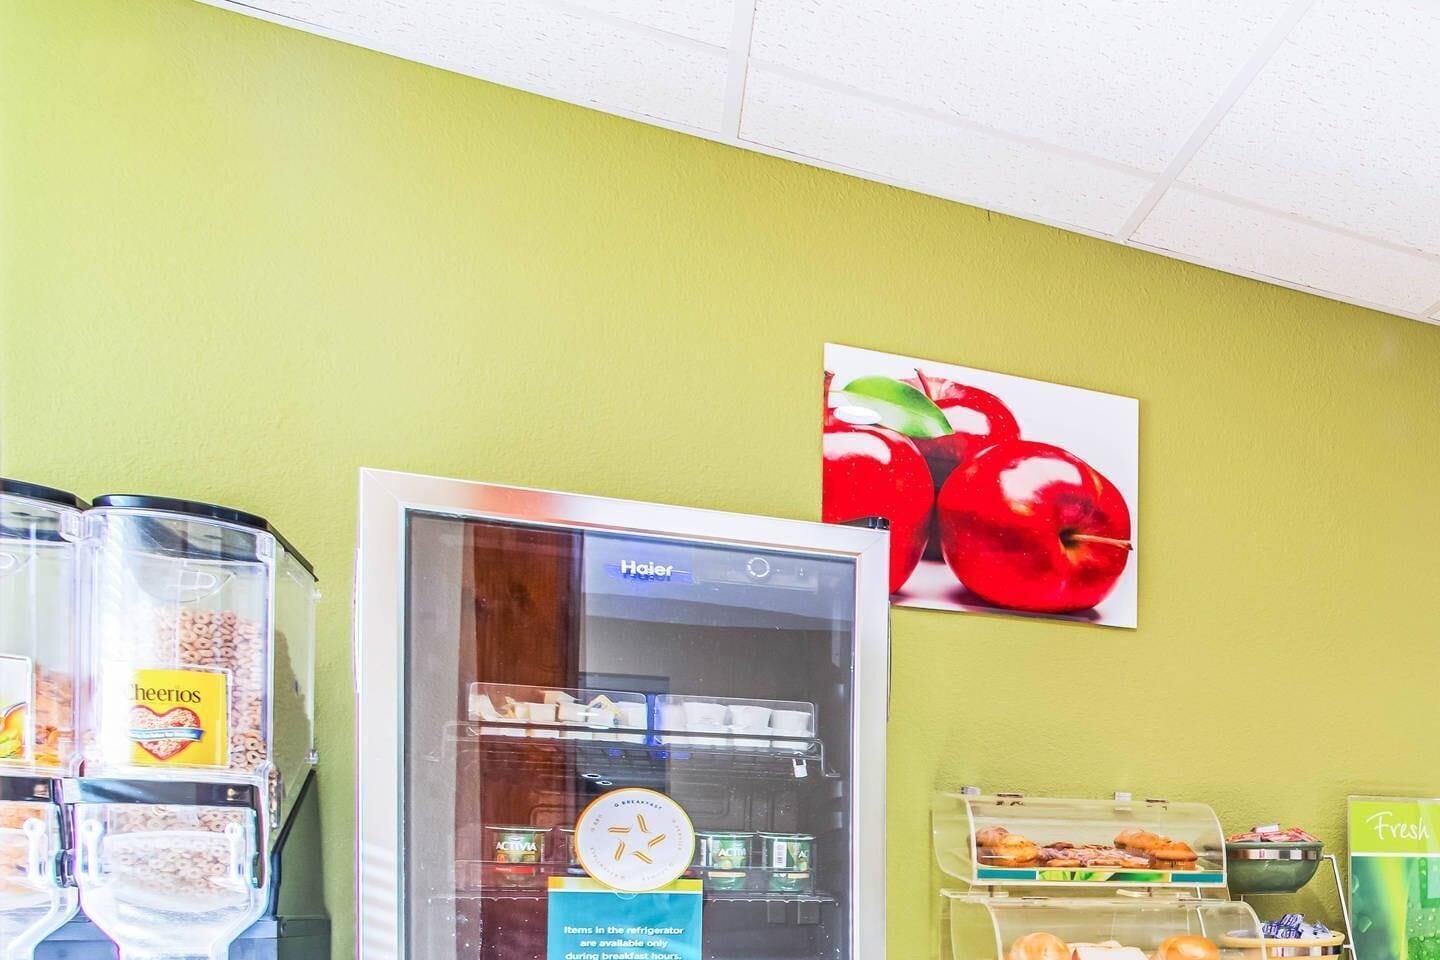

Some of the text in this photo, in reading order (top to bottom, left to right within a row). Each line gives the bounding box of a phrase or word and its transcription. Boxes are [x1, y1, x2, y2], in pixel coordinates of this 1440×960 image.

[620, 559, 673, 576] Haier
[1365, 811, 1430, 841] Fresh
[495, 841, 538, 851] ACTIVIA
[563, 926, 684, 936] Items in the refrigerator
[599, 939, 644, 947] available
[646, 940, 669, 948] only
[565, 952, 683, 960] during breakfast hours.
